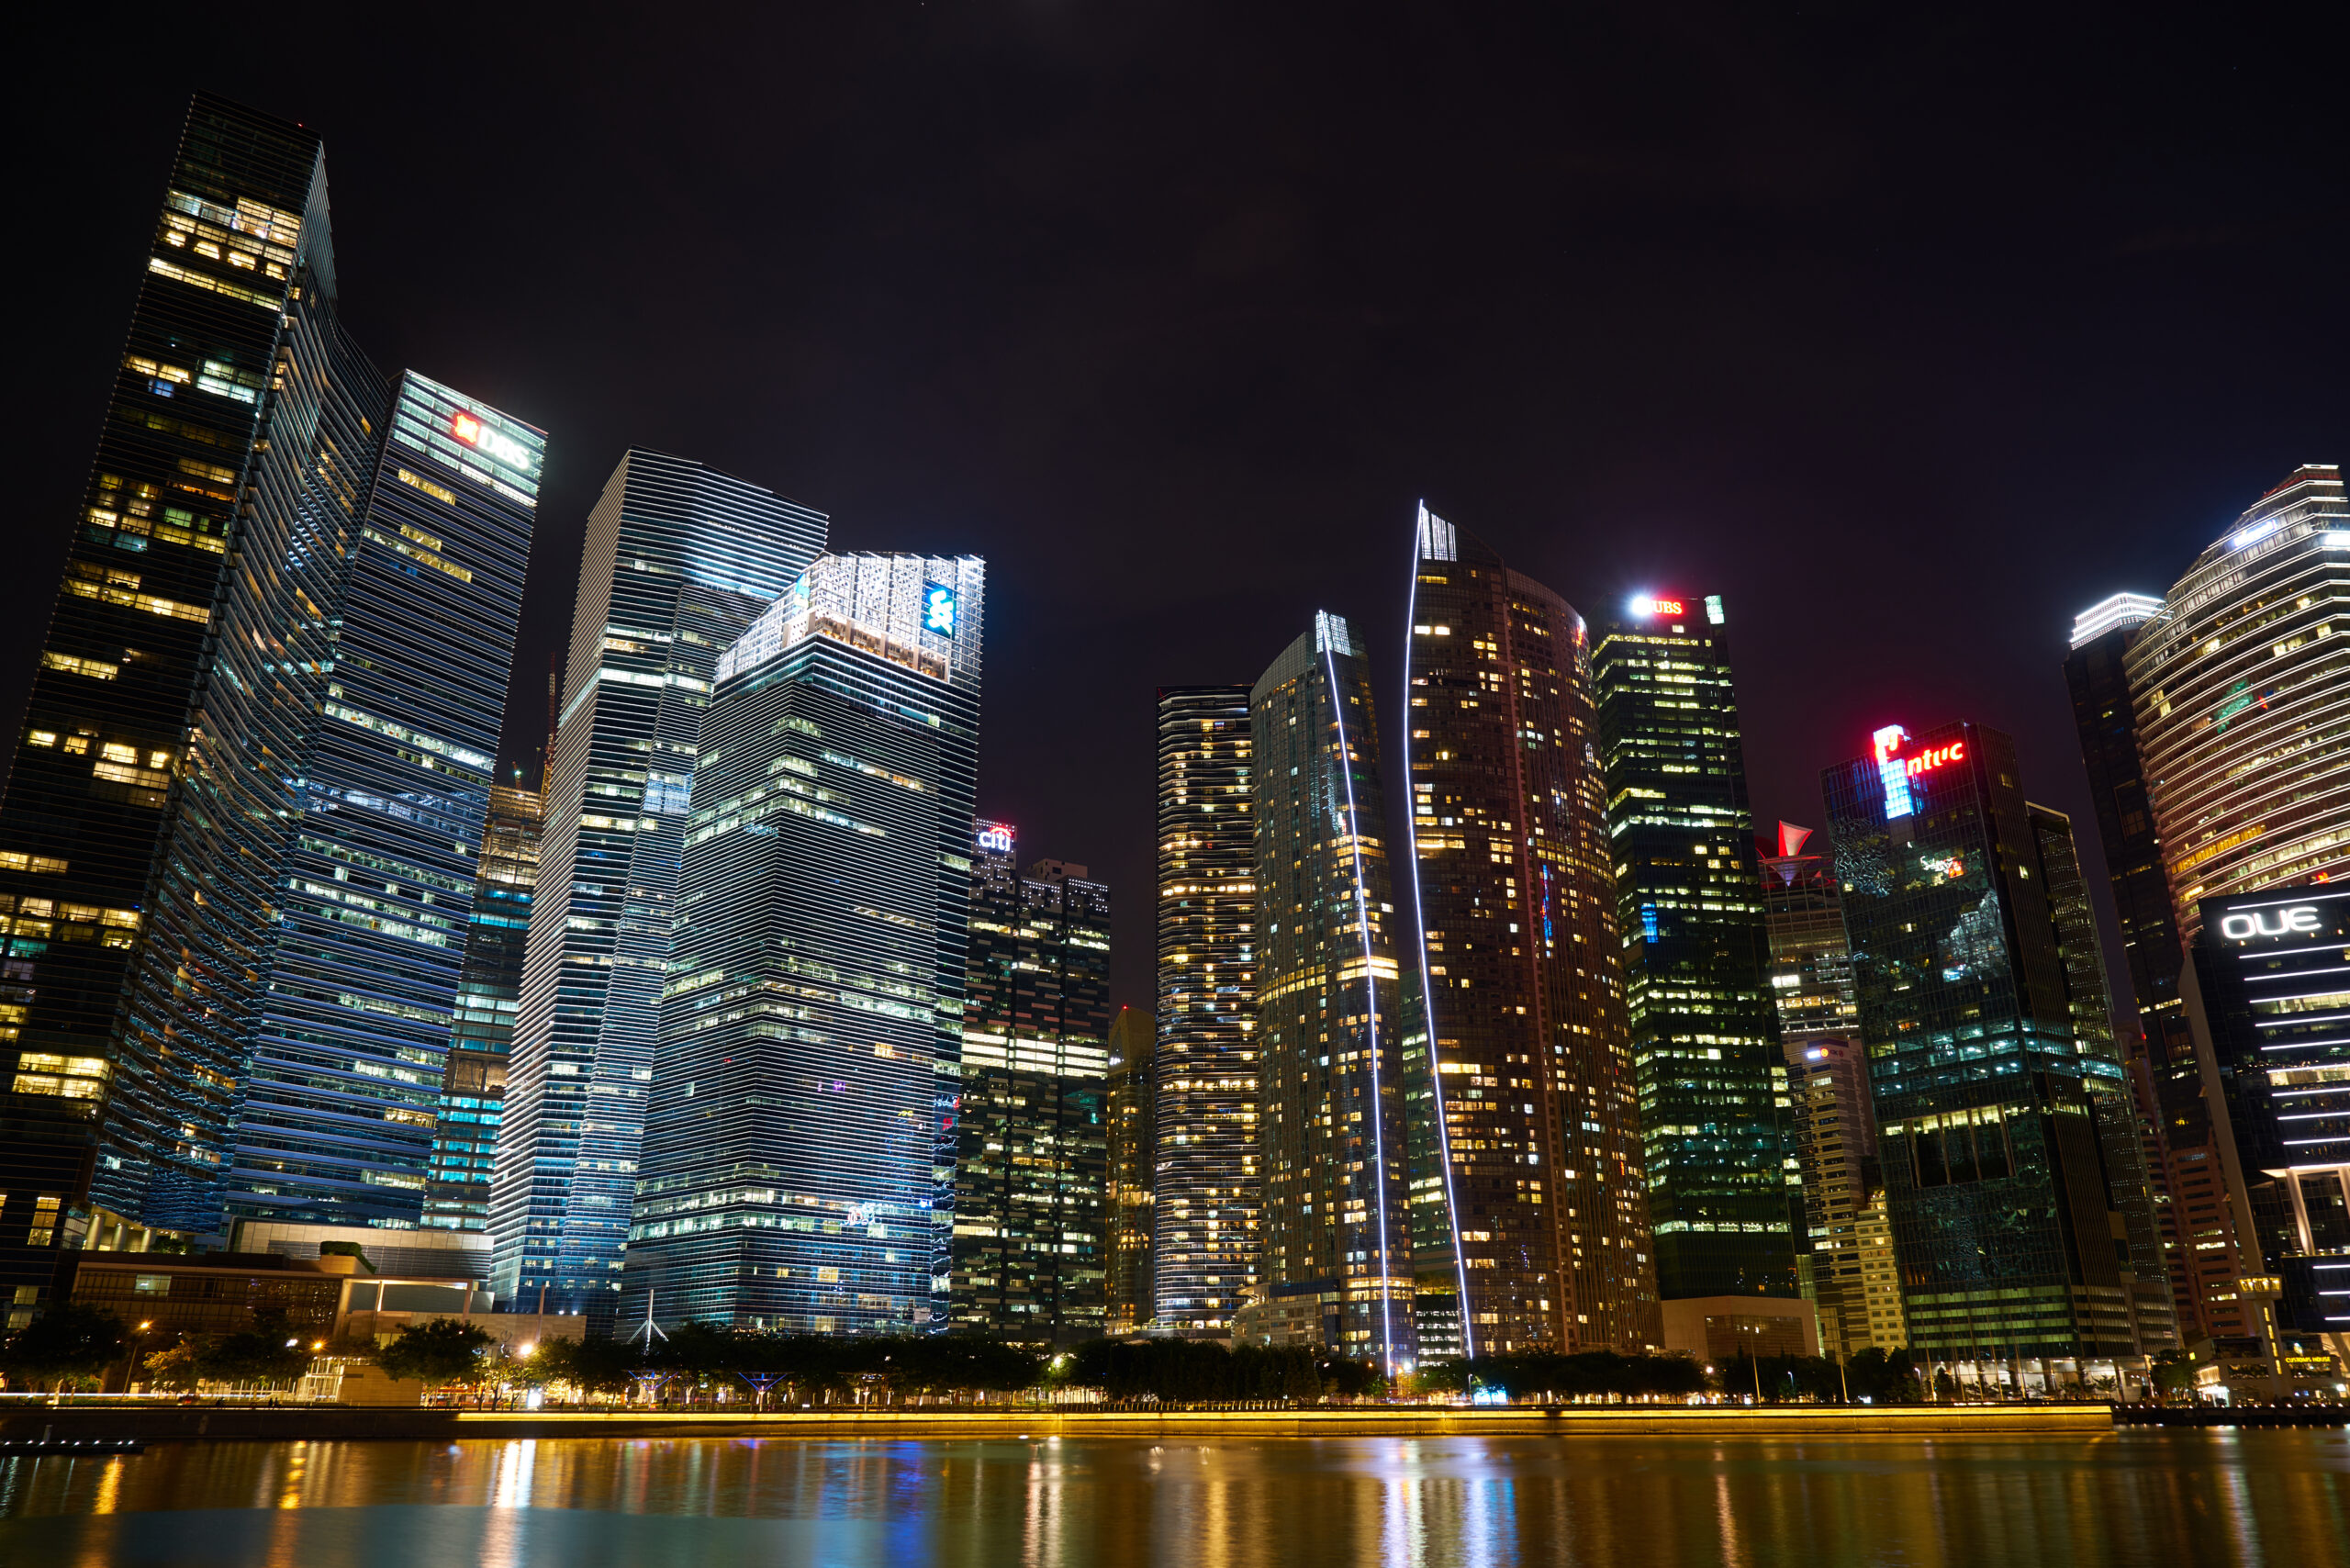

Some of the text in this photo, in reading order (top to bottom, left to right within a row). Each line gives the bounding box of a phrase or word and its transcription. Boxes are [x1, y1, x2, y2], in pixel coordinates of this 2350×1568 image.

[477, 425, 531, 470] DBS
[1651, 599, 1683, 615] UBS
[1907, 743, 1964, 777] ntuc
[979, 830, 1011, 852] citi
[2221, 906, 2322, 939] OUE
